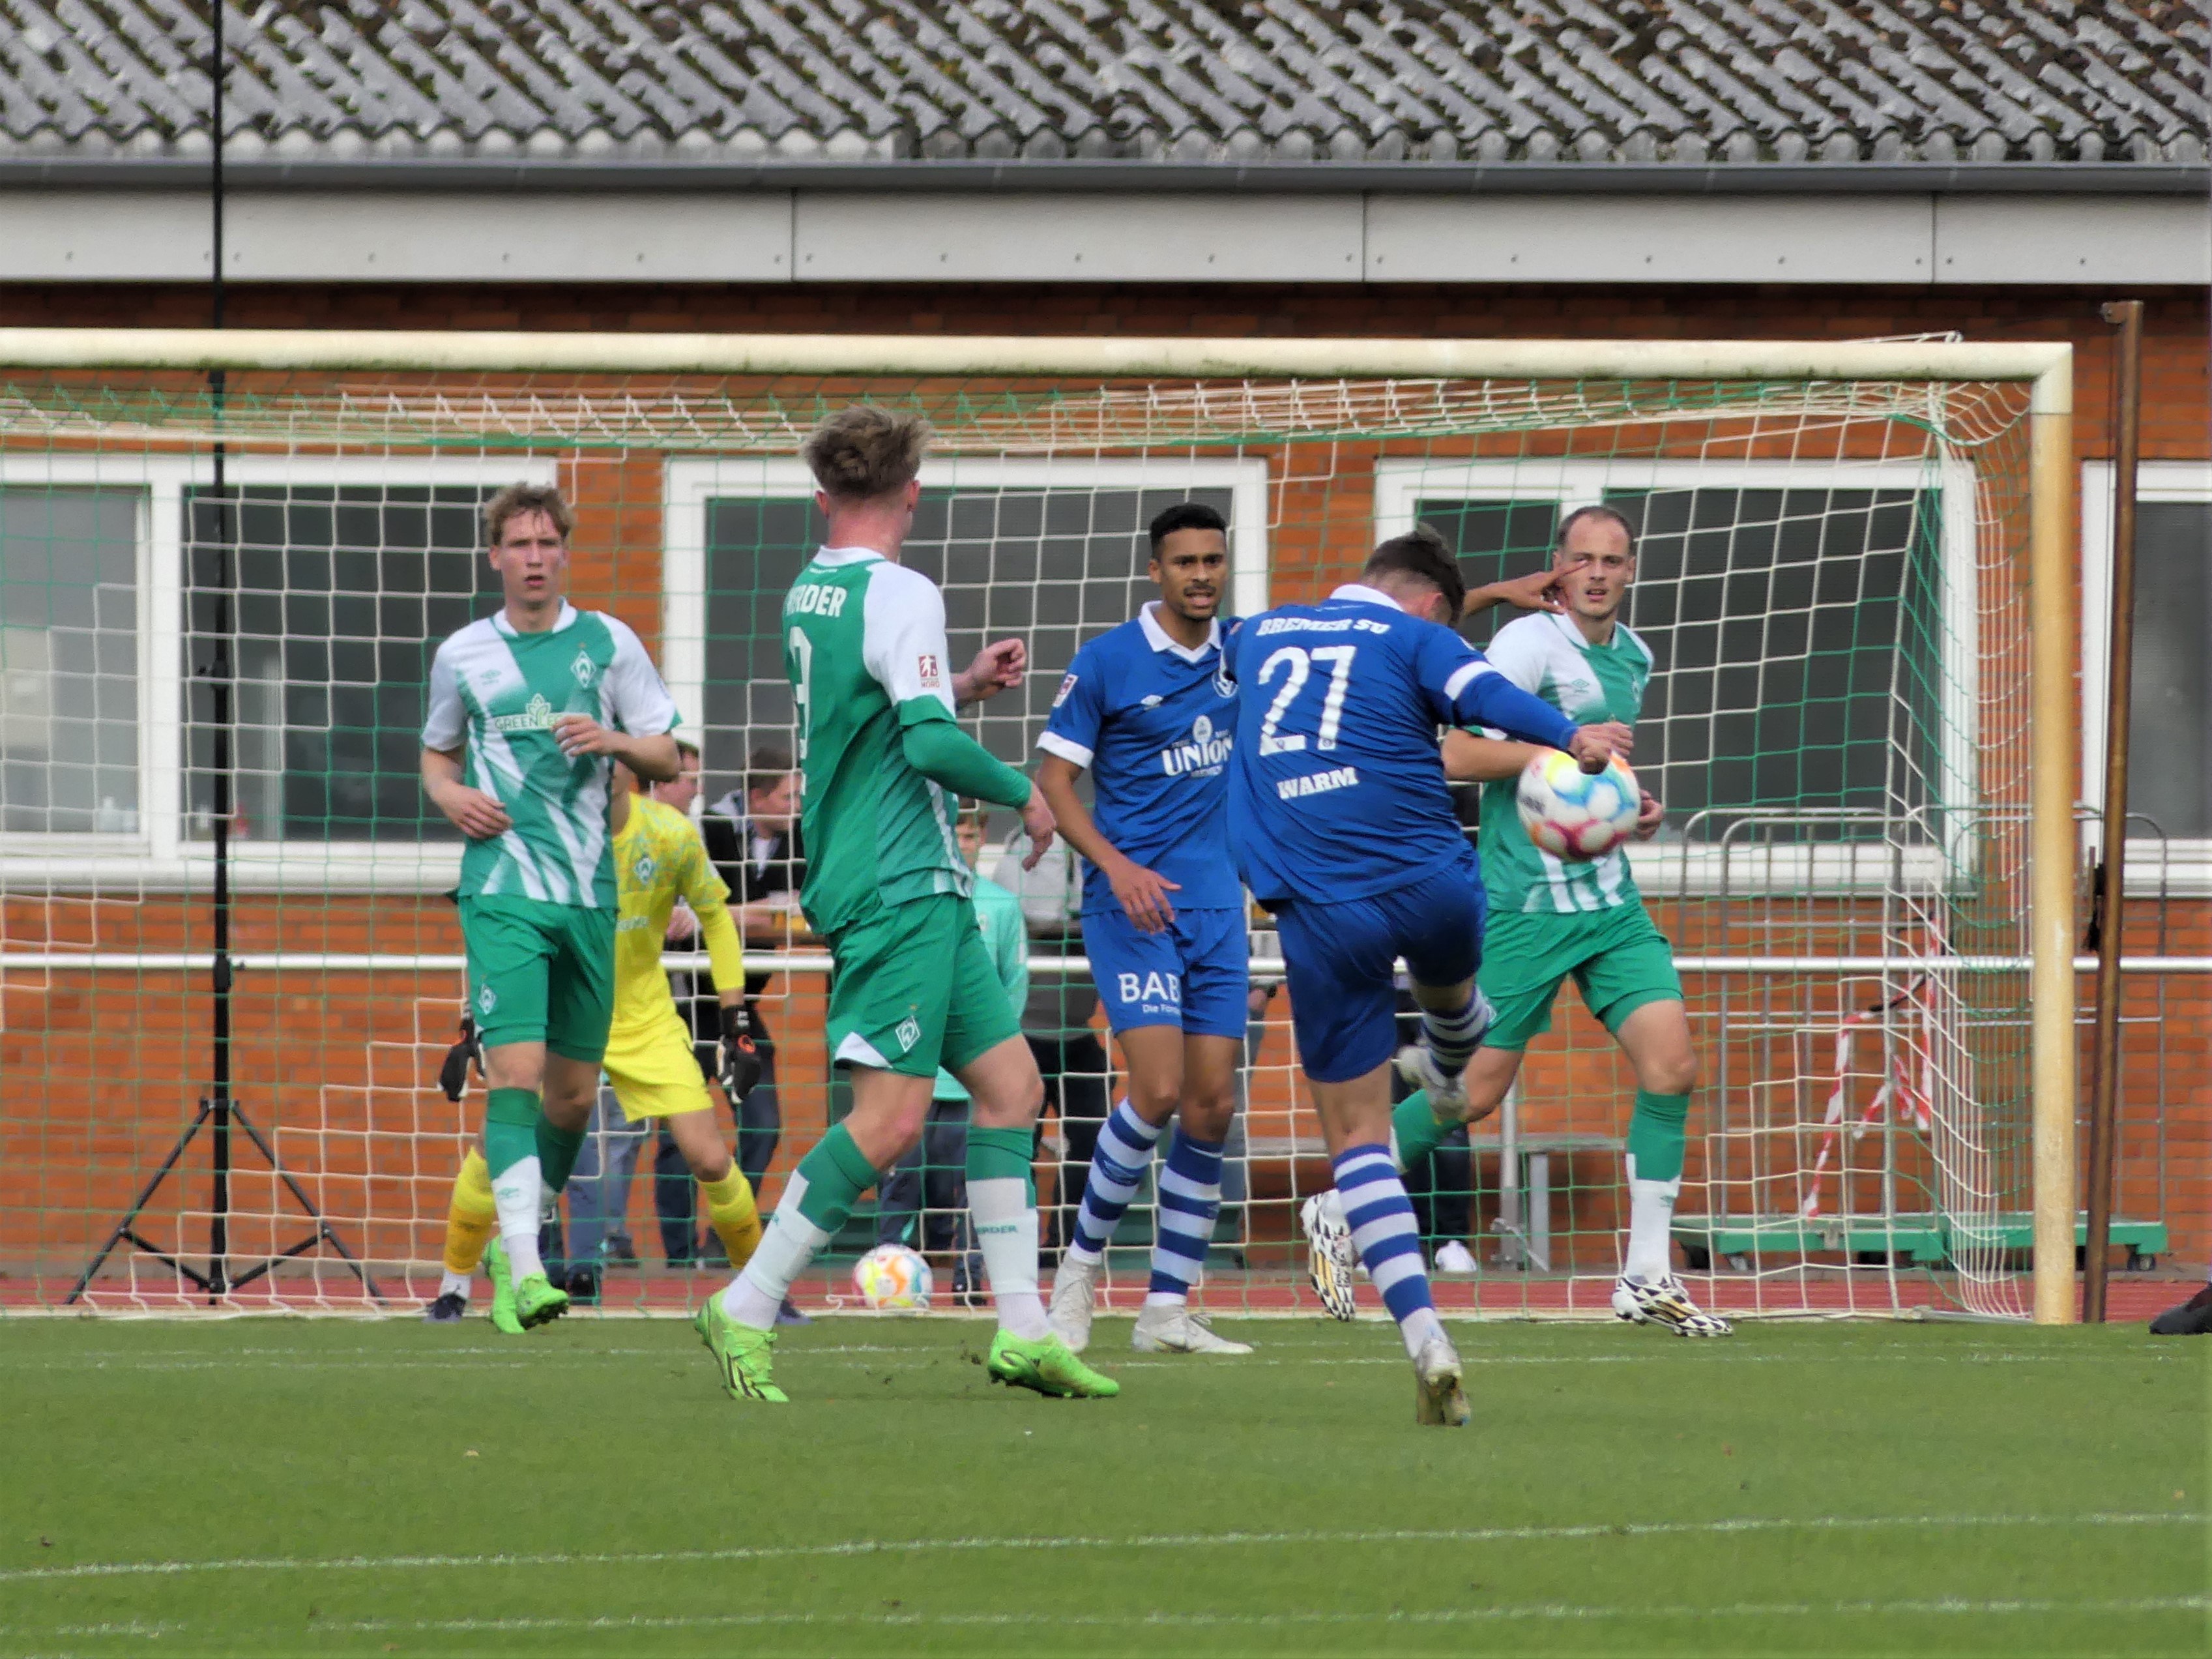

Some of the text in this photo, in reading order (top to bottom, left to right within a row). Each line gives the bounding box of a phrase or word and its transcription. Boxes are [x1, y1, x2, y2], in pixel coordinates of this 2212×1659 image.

[1256, 617, 1352, 636] BREMER
[1259, 645, 1357, 756] 27
[1276, 767, 1360, 799] WARM
